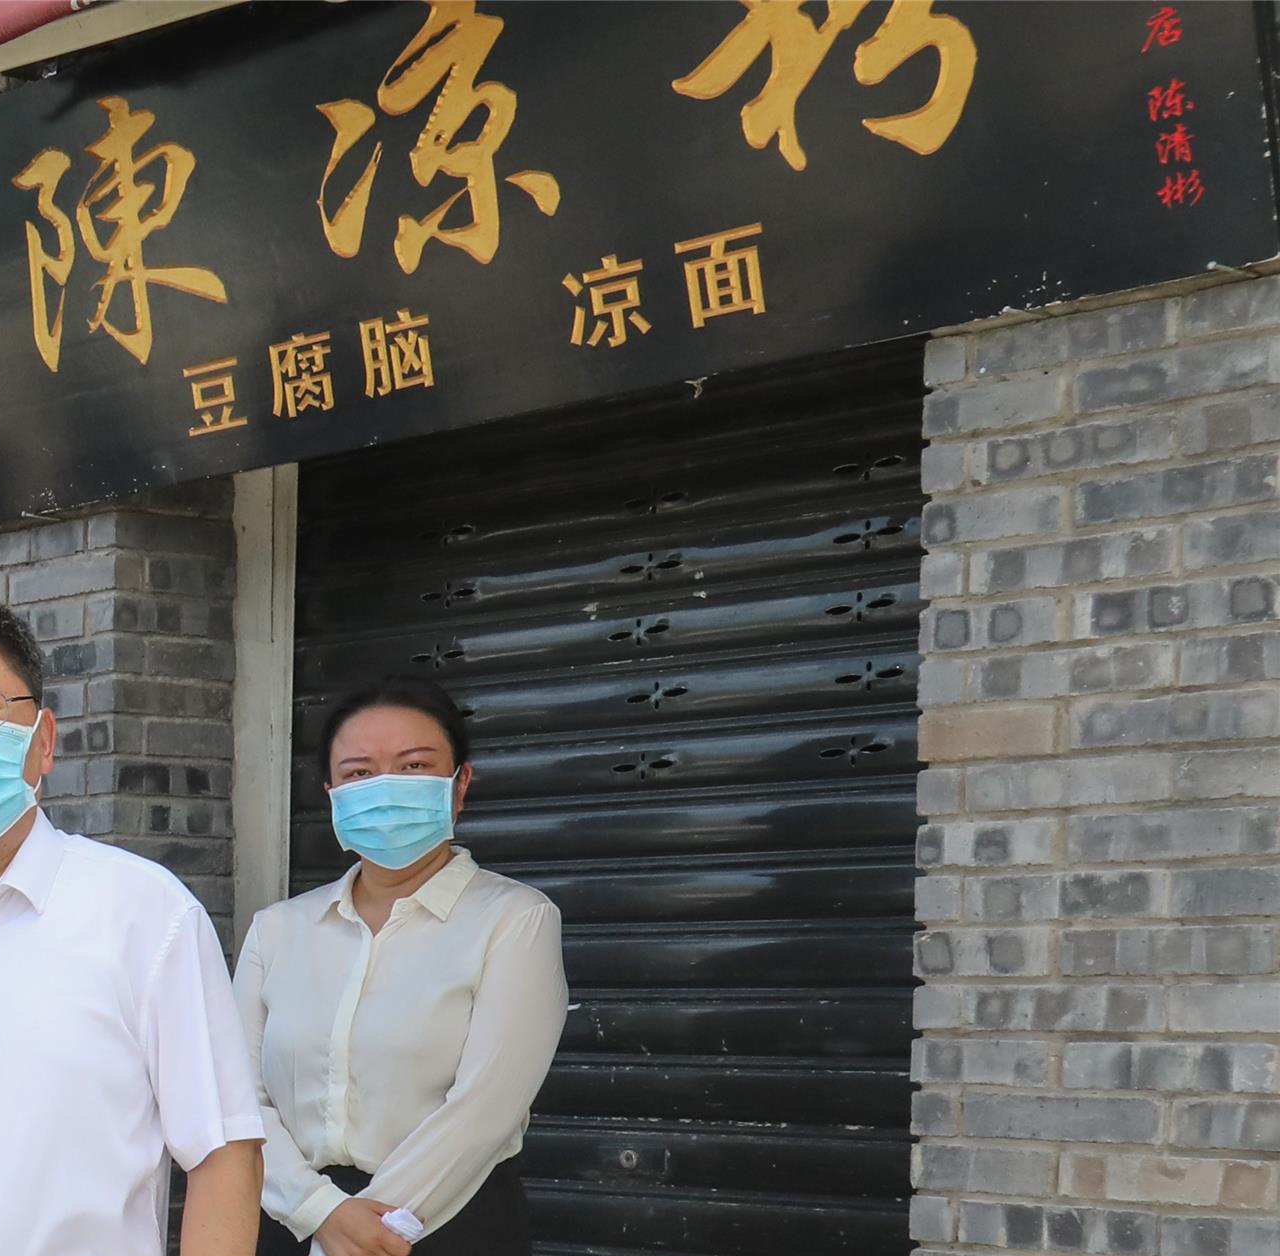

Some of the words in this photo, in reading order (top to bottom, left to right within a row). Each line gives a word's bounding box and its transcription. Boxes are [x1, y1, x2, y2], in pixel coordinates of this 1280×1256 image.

[183, 308, 435, 437] 豆腐脑
[561, 222, 765, 348] 凉面
